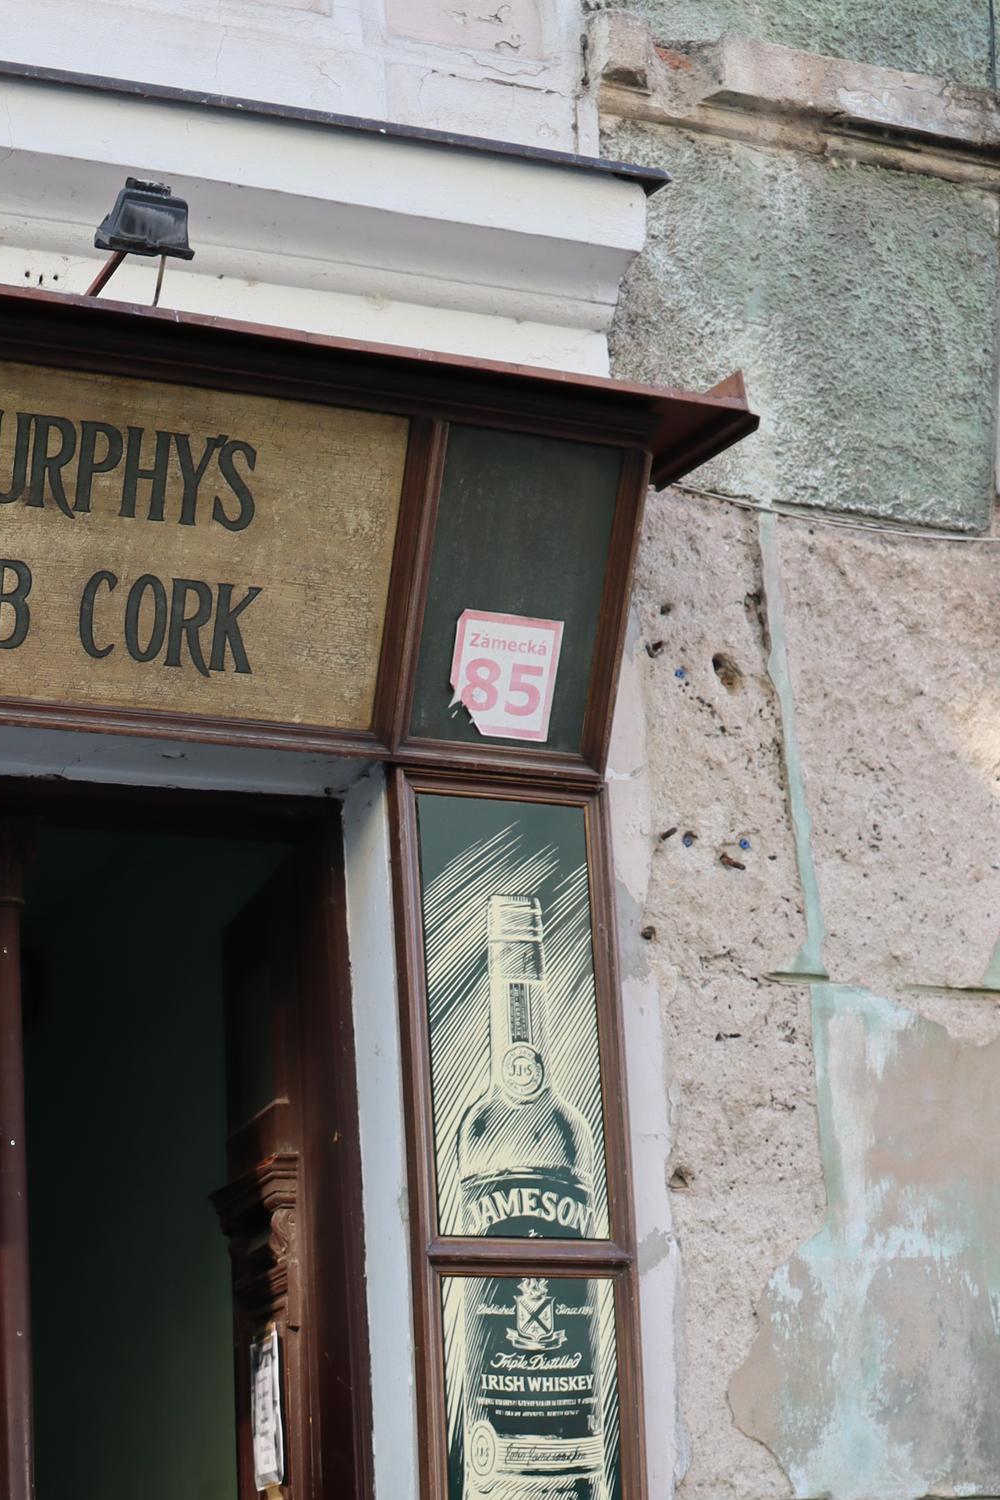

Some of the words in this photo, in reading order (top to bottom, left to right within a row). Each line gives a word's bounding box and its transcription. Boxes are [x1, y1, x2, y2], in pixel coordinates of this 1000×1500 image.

[78, 570, 263, 678] CORK
[469, 632, 547, 656] Zámecká
[461, 657, 544, 717] 85
[468, 1187, 593, 1233] JAMESON
[490, 1352, 528, 1371] Triple
[481, 1374, 525, 1392] IRISH
[528, 1374, 594, 1392] WHISKEY
